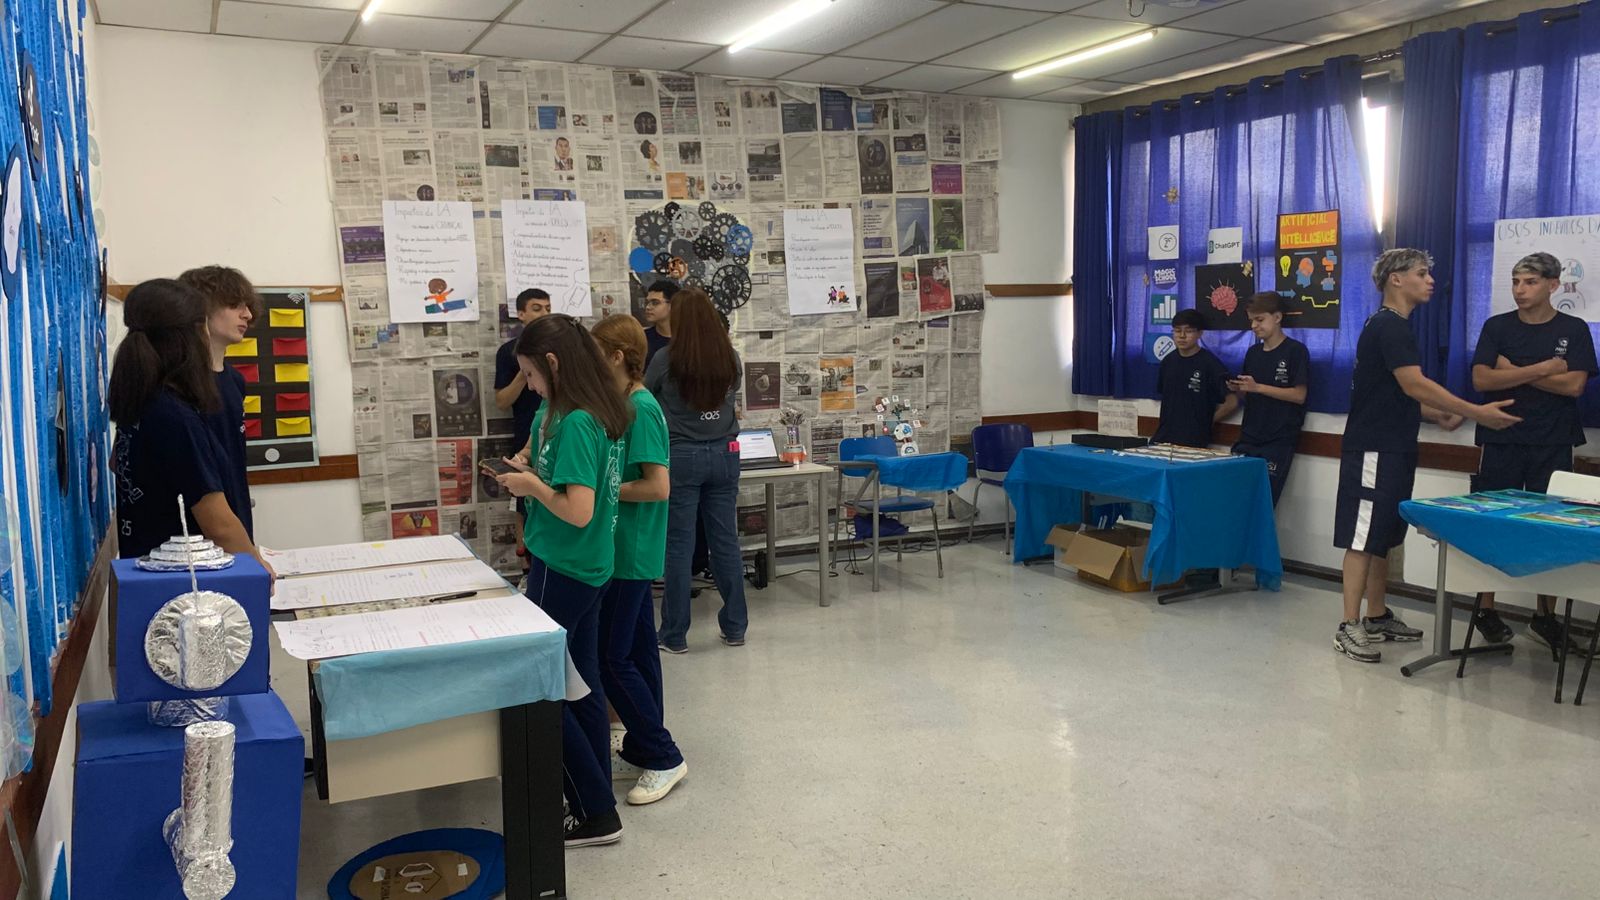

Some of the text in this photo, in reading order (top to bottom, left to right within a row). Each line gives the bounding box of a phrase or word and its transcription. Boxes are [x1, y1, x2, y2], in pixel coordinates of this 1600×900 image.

[1280, 213, 1328, 227] ARTIFICIAL
[1280, 229, 1335, 245] INTELLIGENCE
[1214, 241, 1240, 249] ChatGPT
[1154, 267, 1176, 276] MAGIC
[1155, 274, 1177, 282] SCHOOL
[700, 410, 720, 420] 2025
